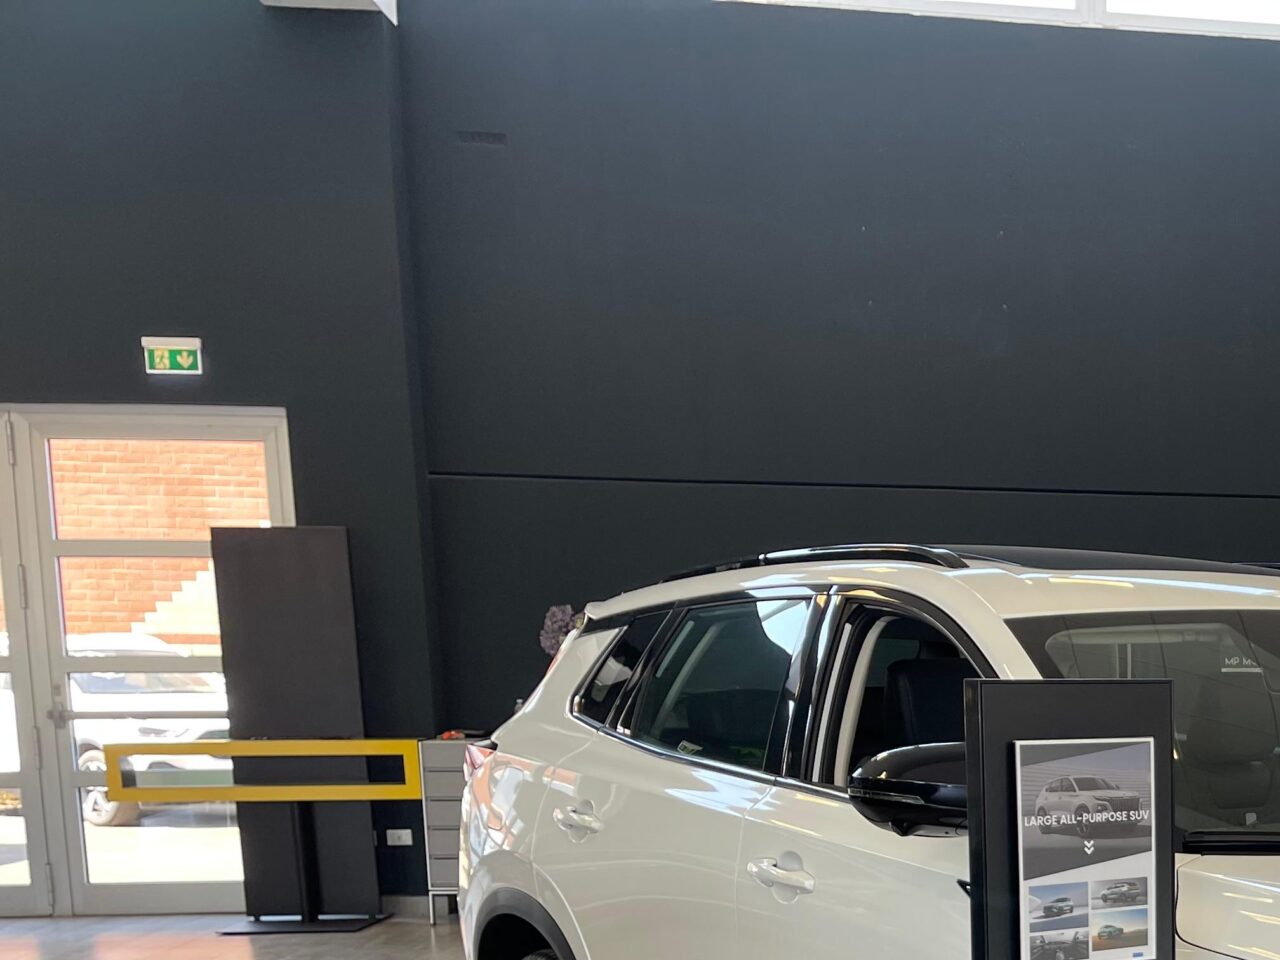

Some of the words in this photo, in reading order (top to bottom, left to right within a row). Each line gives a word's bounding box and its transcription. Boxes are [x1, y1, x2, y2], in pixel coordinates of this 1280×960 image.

[1024, 814, 1058, 827] LARGE
[1060, 811, 1128, 825] ALL-PURPOSE
[1130, 809, 1150, 821] SUV
